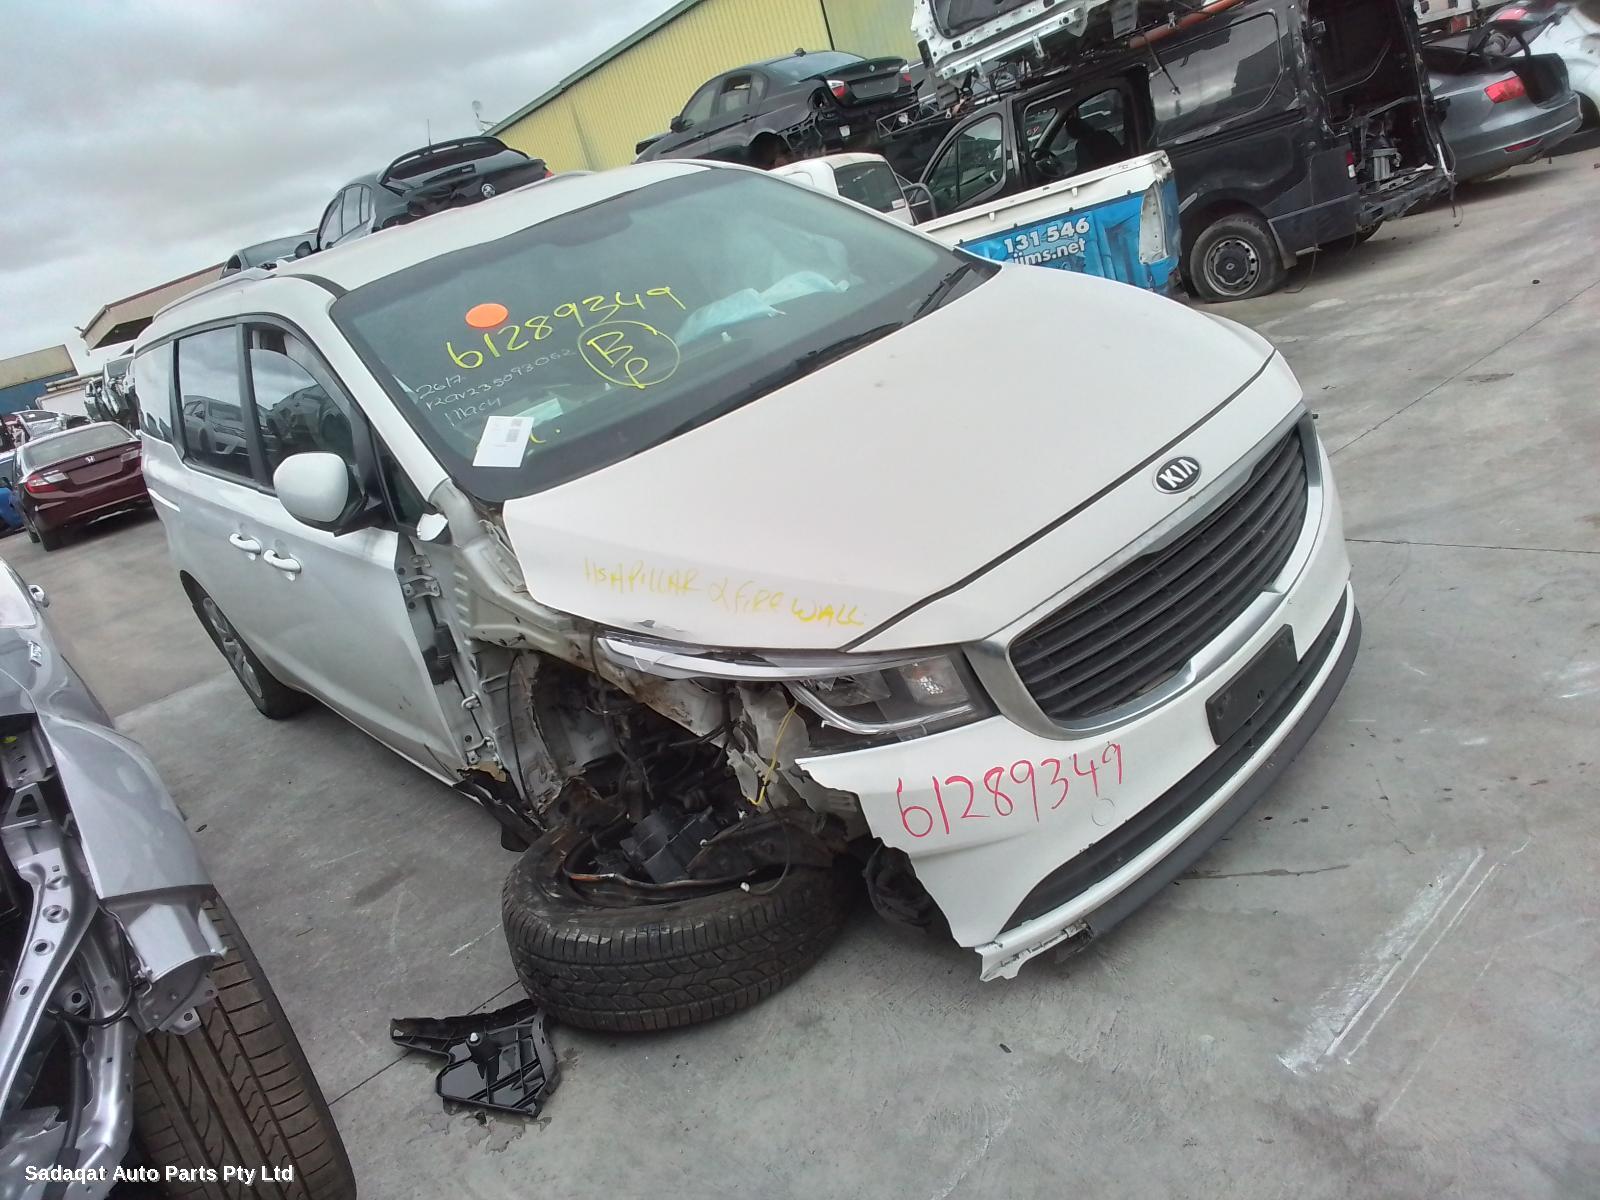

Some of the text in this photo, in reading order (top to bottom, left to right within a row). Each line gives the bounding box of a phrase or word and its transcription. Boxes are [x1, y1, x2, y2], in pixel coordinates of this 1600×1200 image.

[1003, 217, 1090, 254] 131 546
[446, 286, 687, 369] 61289349
[1158, 458, 1199, 488] KIA
[895, 740, 1123, 838] 61289349
